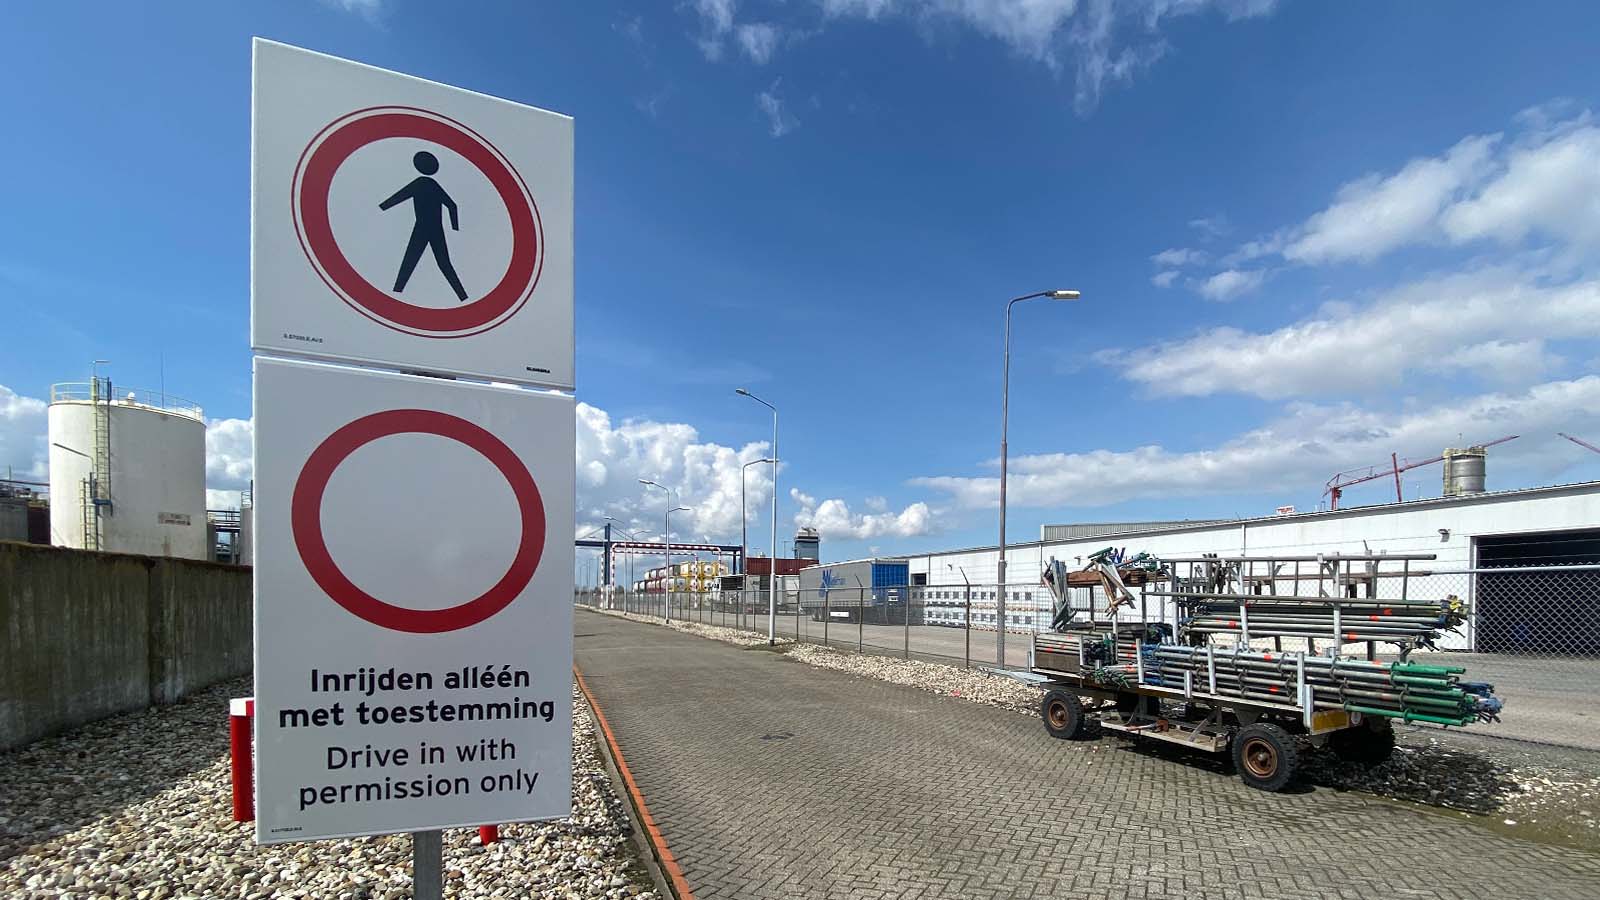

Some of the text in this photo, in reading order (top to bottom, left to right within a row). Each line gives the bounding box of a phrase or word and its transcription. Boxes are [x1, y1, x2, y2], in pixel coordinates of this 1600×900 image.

[312, 665, 529, 696] Inrijden alléén
[279, 697, 554, 728] met toestemming
[328, 738, 516, 769] Drive in with
[300, 769, 539, 811] permission only
